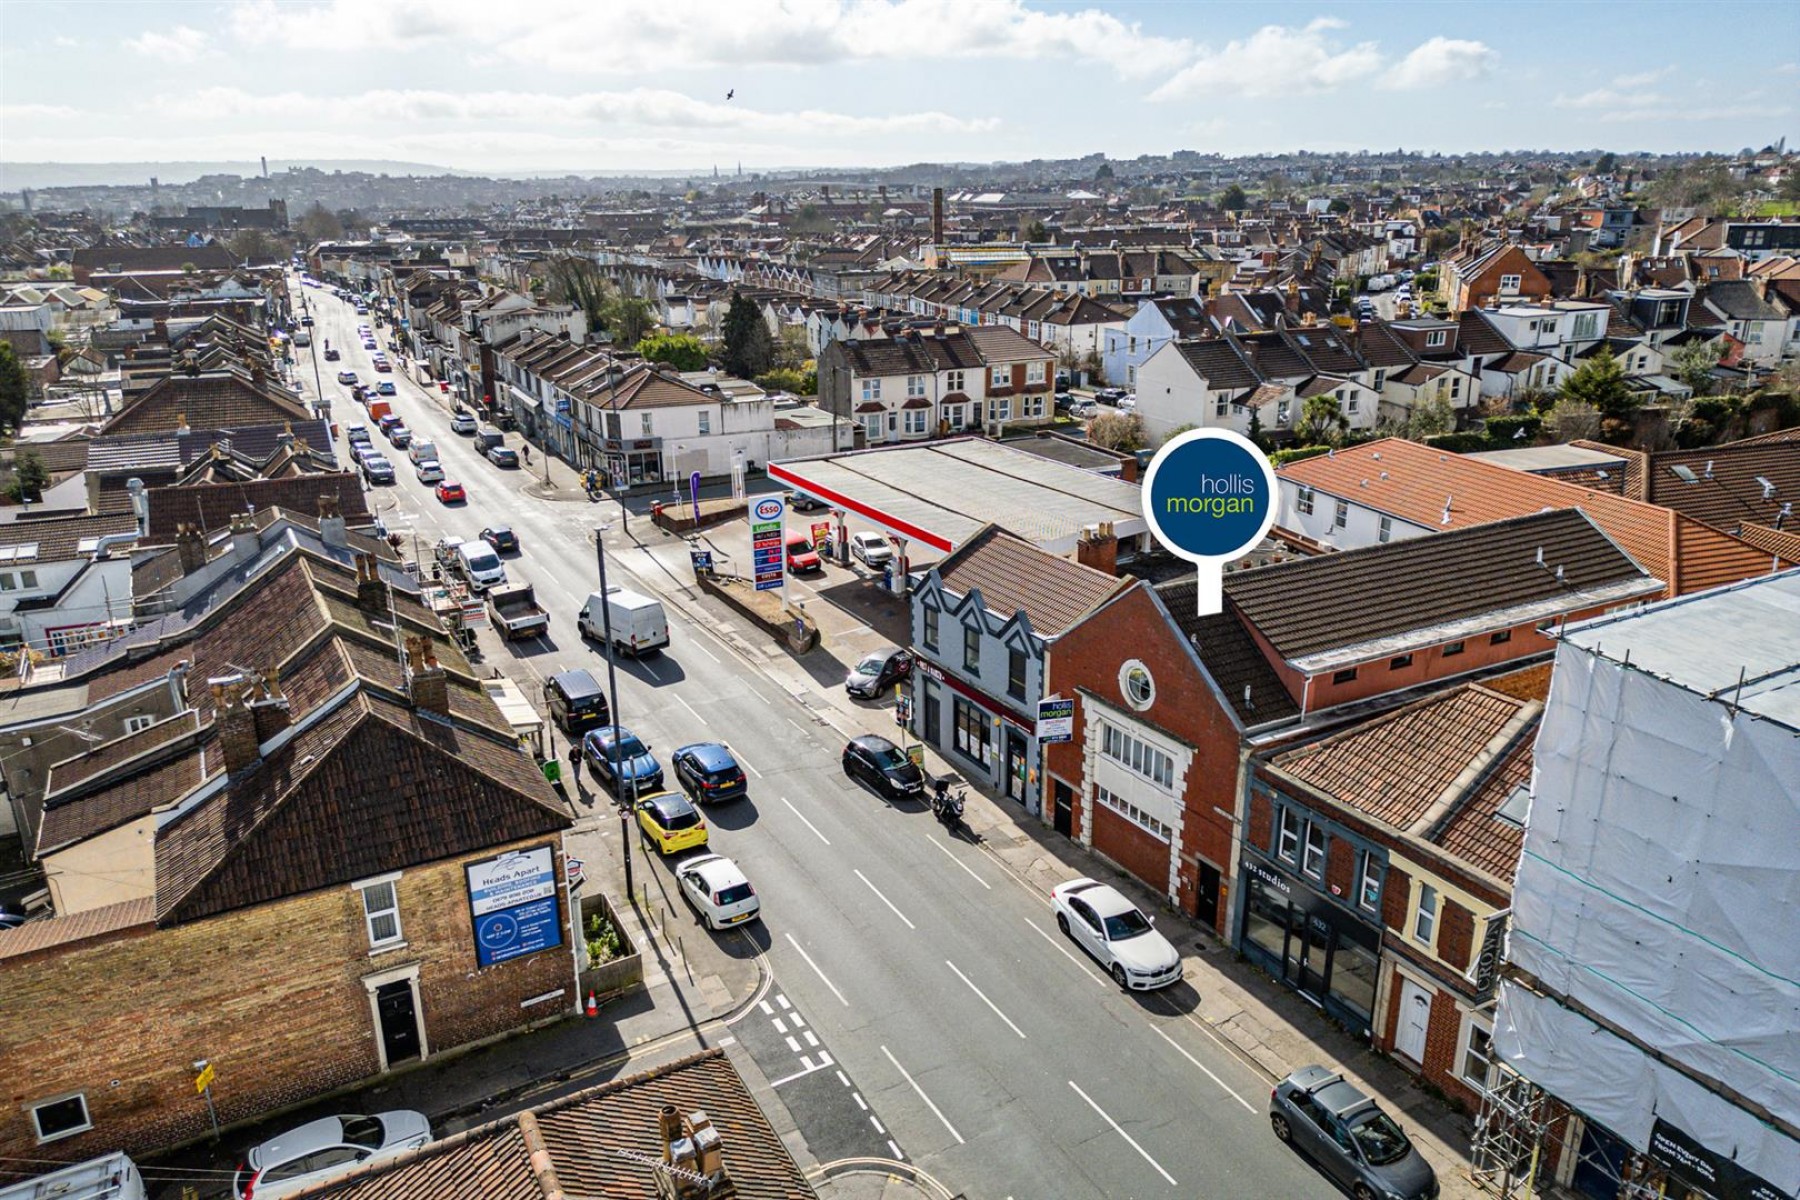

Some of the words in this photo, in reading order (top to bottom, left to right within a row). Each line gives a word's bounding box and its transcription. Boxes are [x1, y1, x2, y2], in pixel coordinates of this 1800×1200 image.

[759, 505, 779, 514] Esso
[1041, 709, 1072, 720] morgan
[1052, 701, 1072, 710] hollis
[483, 874, 511, 886] Heads
[514, 866, 541, 878] Apart
[1245, 861, 1258, 873] 432
[1258, 868, 1291, 894] studios
[1477, 921, 1500, 991] CROWN
[1654, 1140, 1677, 1157] FROM
[1676, 1154, 1692, 1167] 7AM
[1656, 1132, 1680, 1150] OPEN
[1677, 1143, 1700, 1163] EVERY
[1700, 1159, 1715, 1174] DAY
